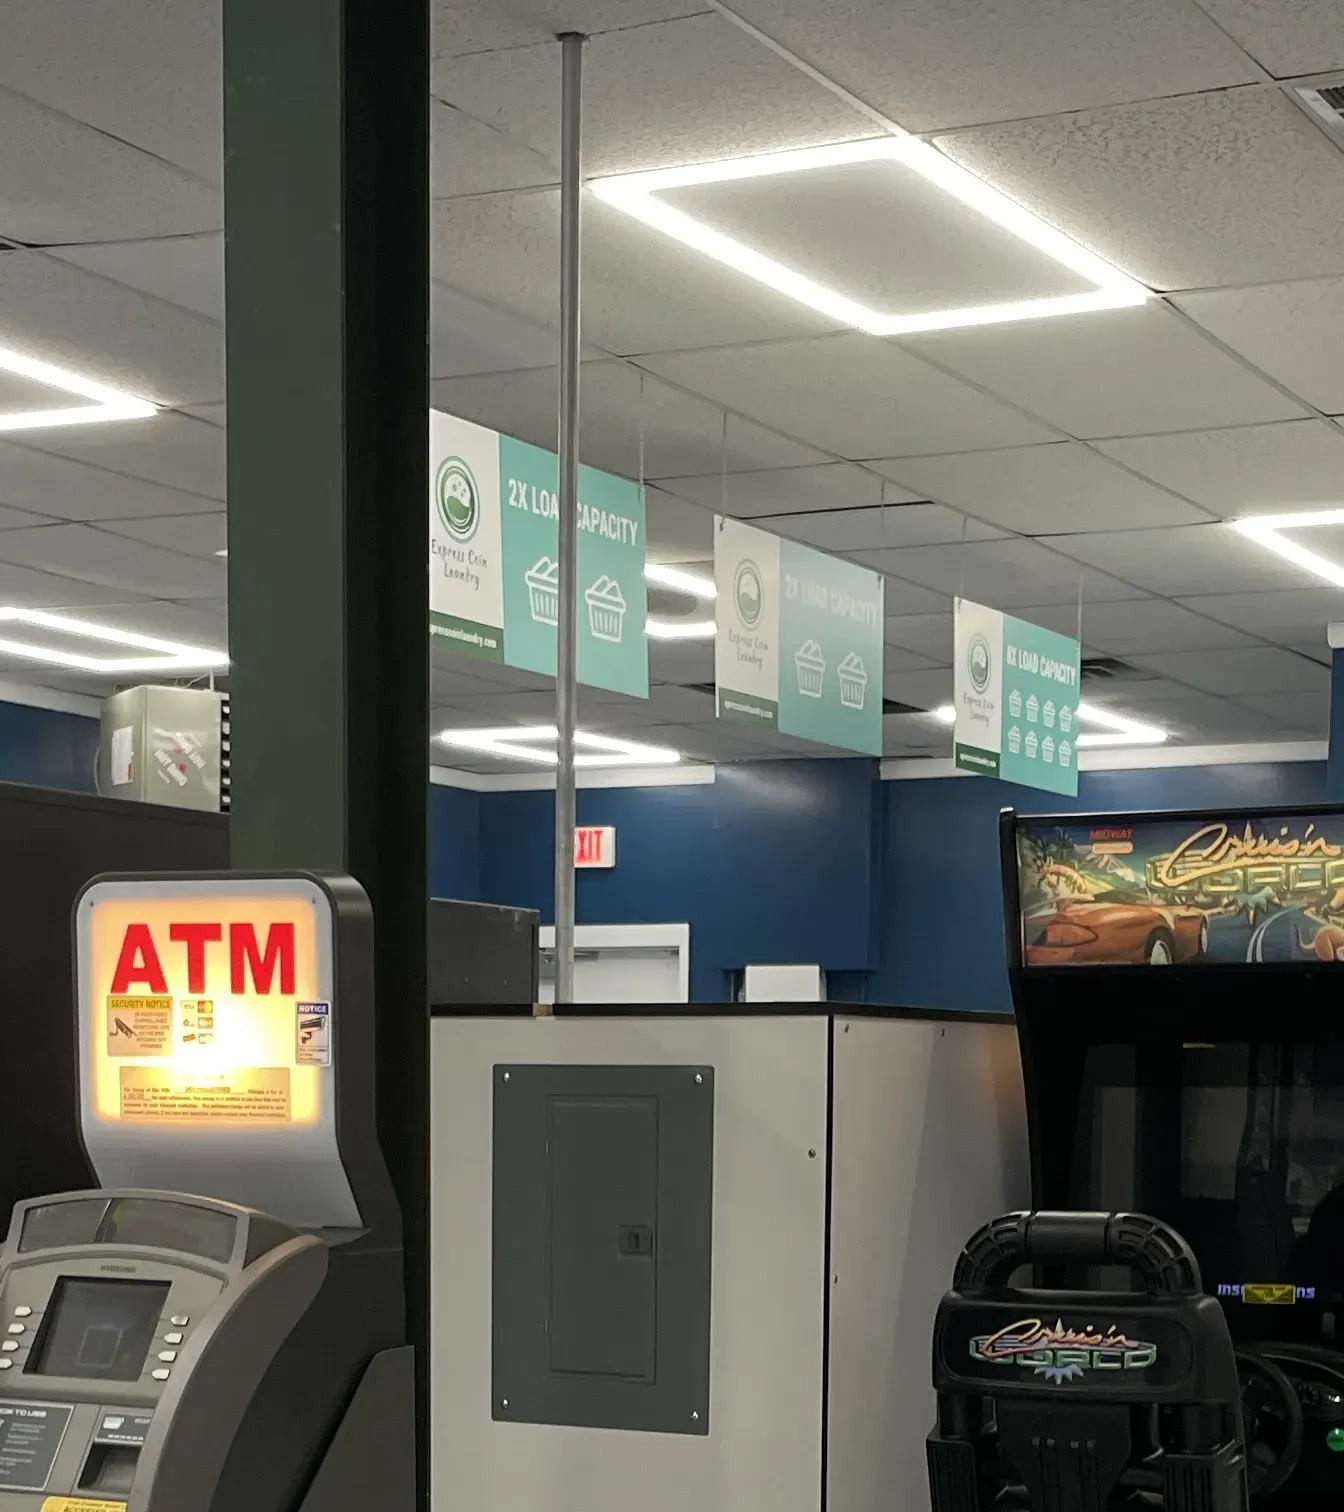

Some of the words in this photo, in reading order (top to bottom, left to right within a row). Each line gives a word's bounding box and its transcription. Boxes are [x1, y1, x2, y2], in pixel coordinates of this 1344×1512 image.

[508, 478, 528, 511] 2X
[532, 486, 559, 521] LOA
[576, 502, 639, 546] CAPACITY
[431, 539, 465, 563] Express
[468, 549, 488, 569] Coin
[444, 563, 480, 590] Laundry
[1019, 649, 1038, 675] LOAD
[1040, 656, 1077, 686] CAPACITY
[576, 830, 604, 862] XIT
[109, 921, 297, 995] ATM
[298, 1004, 327, 1014] NOTICE
